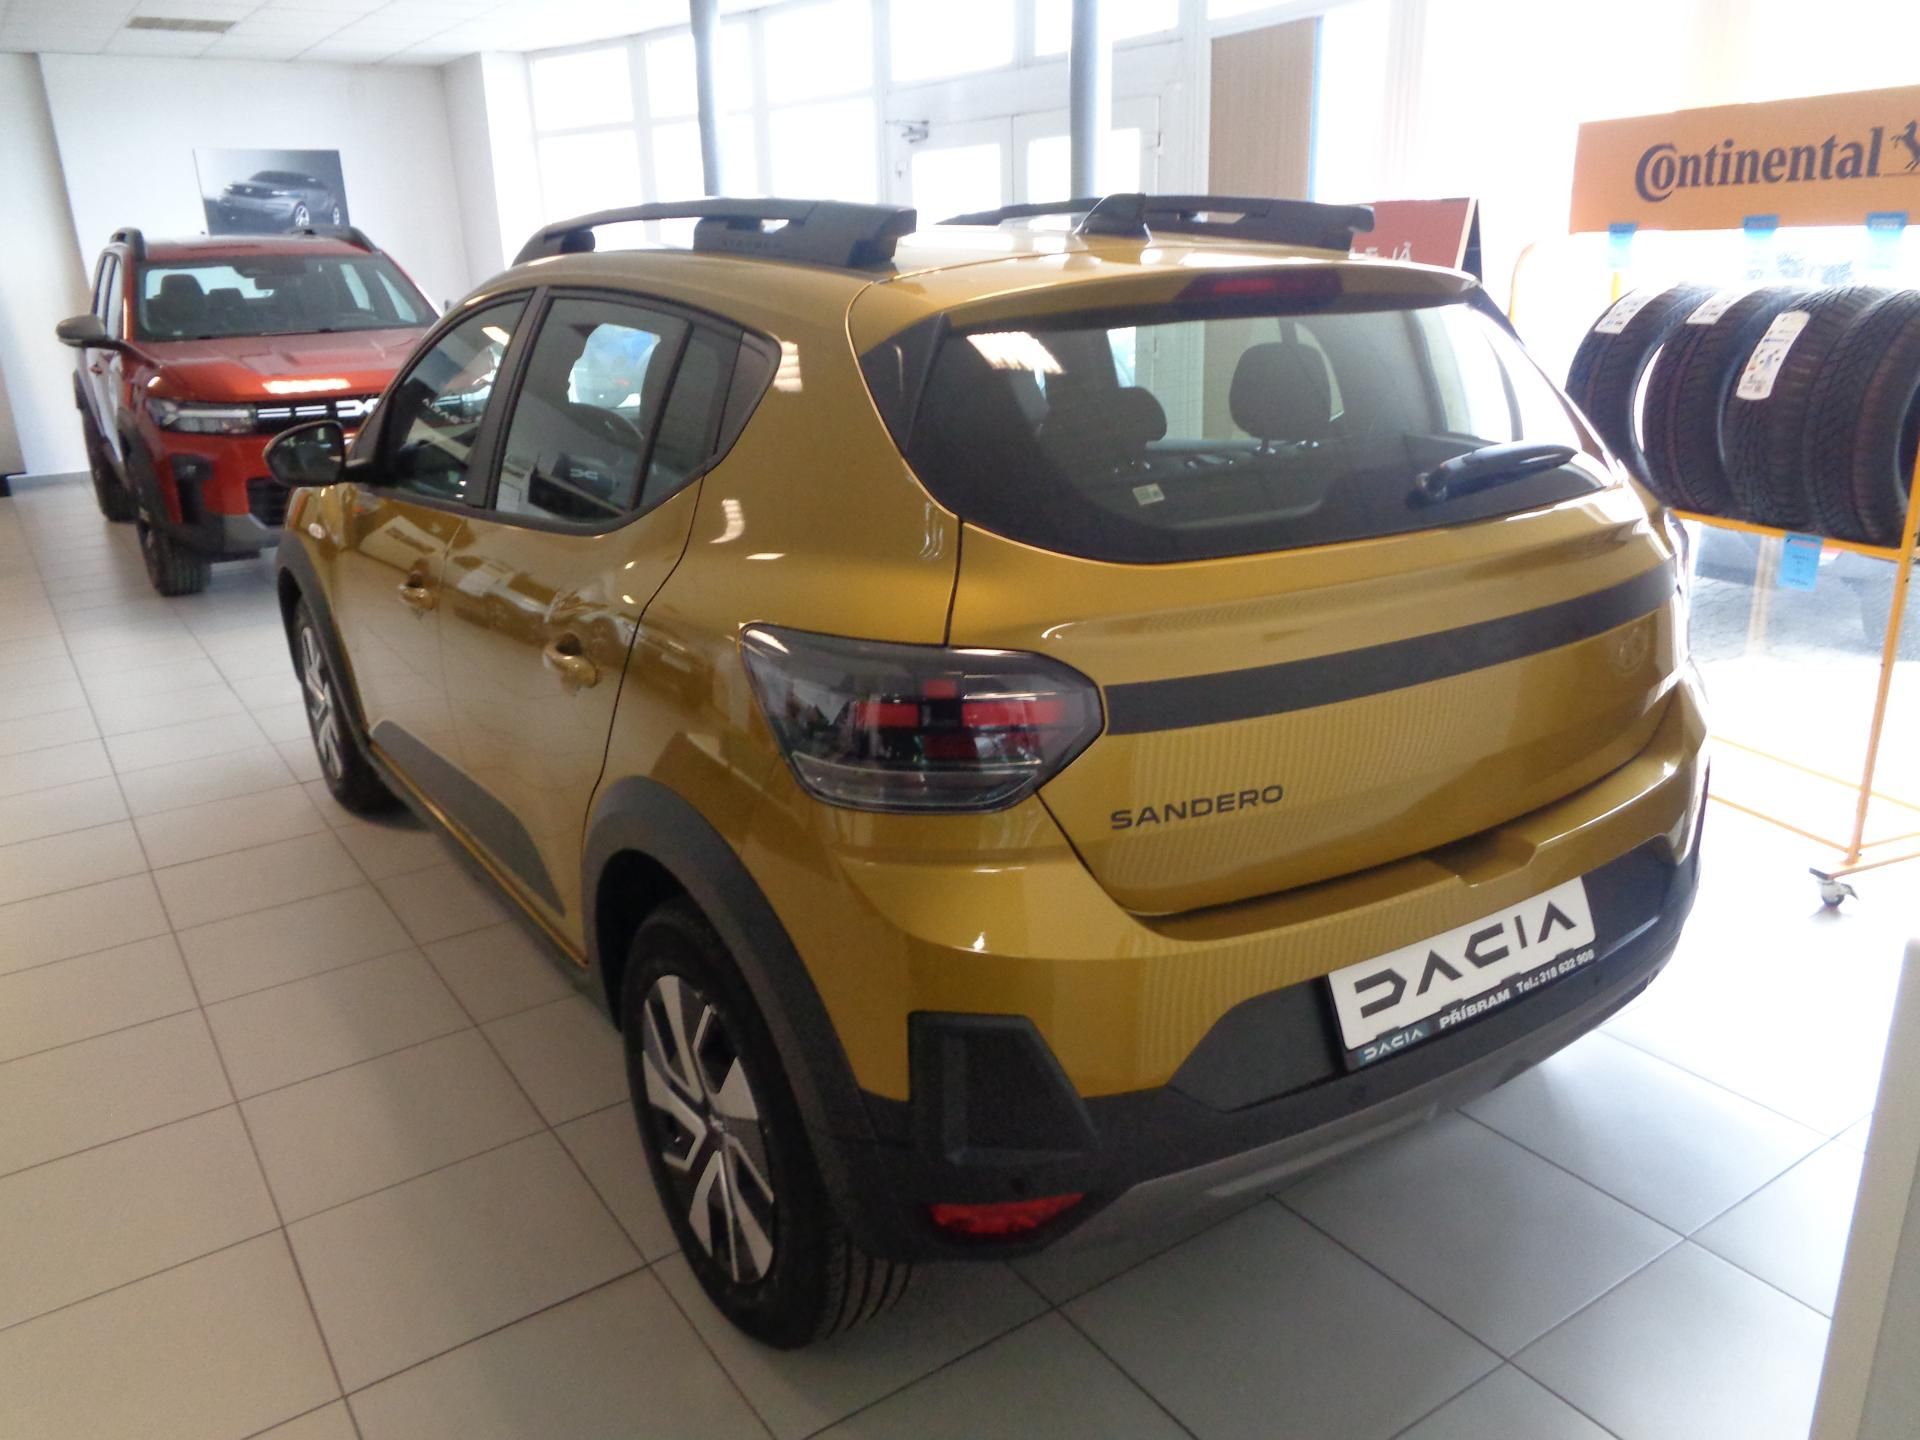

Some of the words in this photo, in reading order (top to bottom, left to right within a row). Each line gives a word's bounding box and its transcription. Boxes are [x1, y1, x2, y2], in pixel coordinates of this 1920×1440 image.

[1635, 126, 1885, 202] Continental
[1110, 784, 1284, 829] SANDERO
[1353, 900, 1577, 1019] DACIA
[1363, 1029, 1425, 1061] DACIA
[1438, 988, 1511, 1029] PŘÍBRAM
